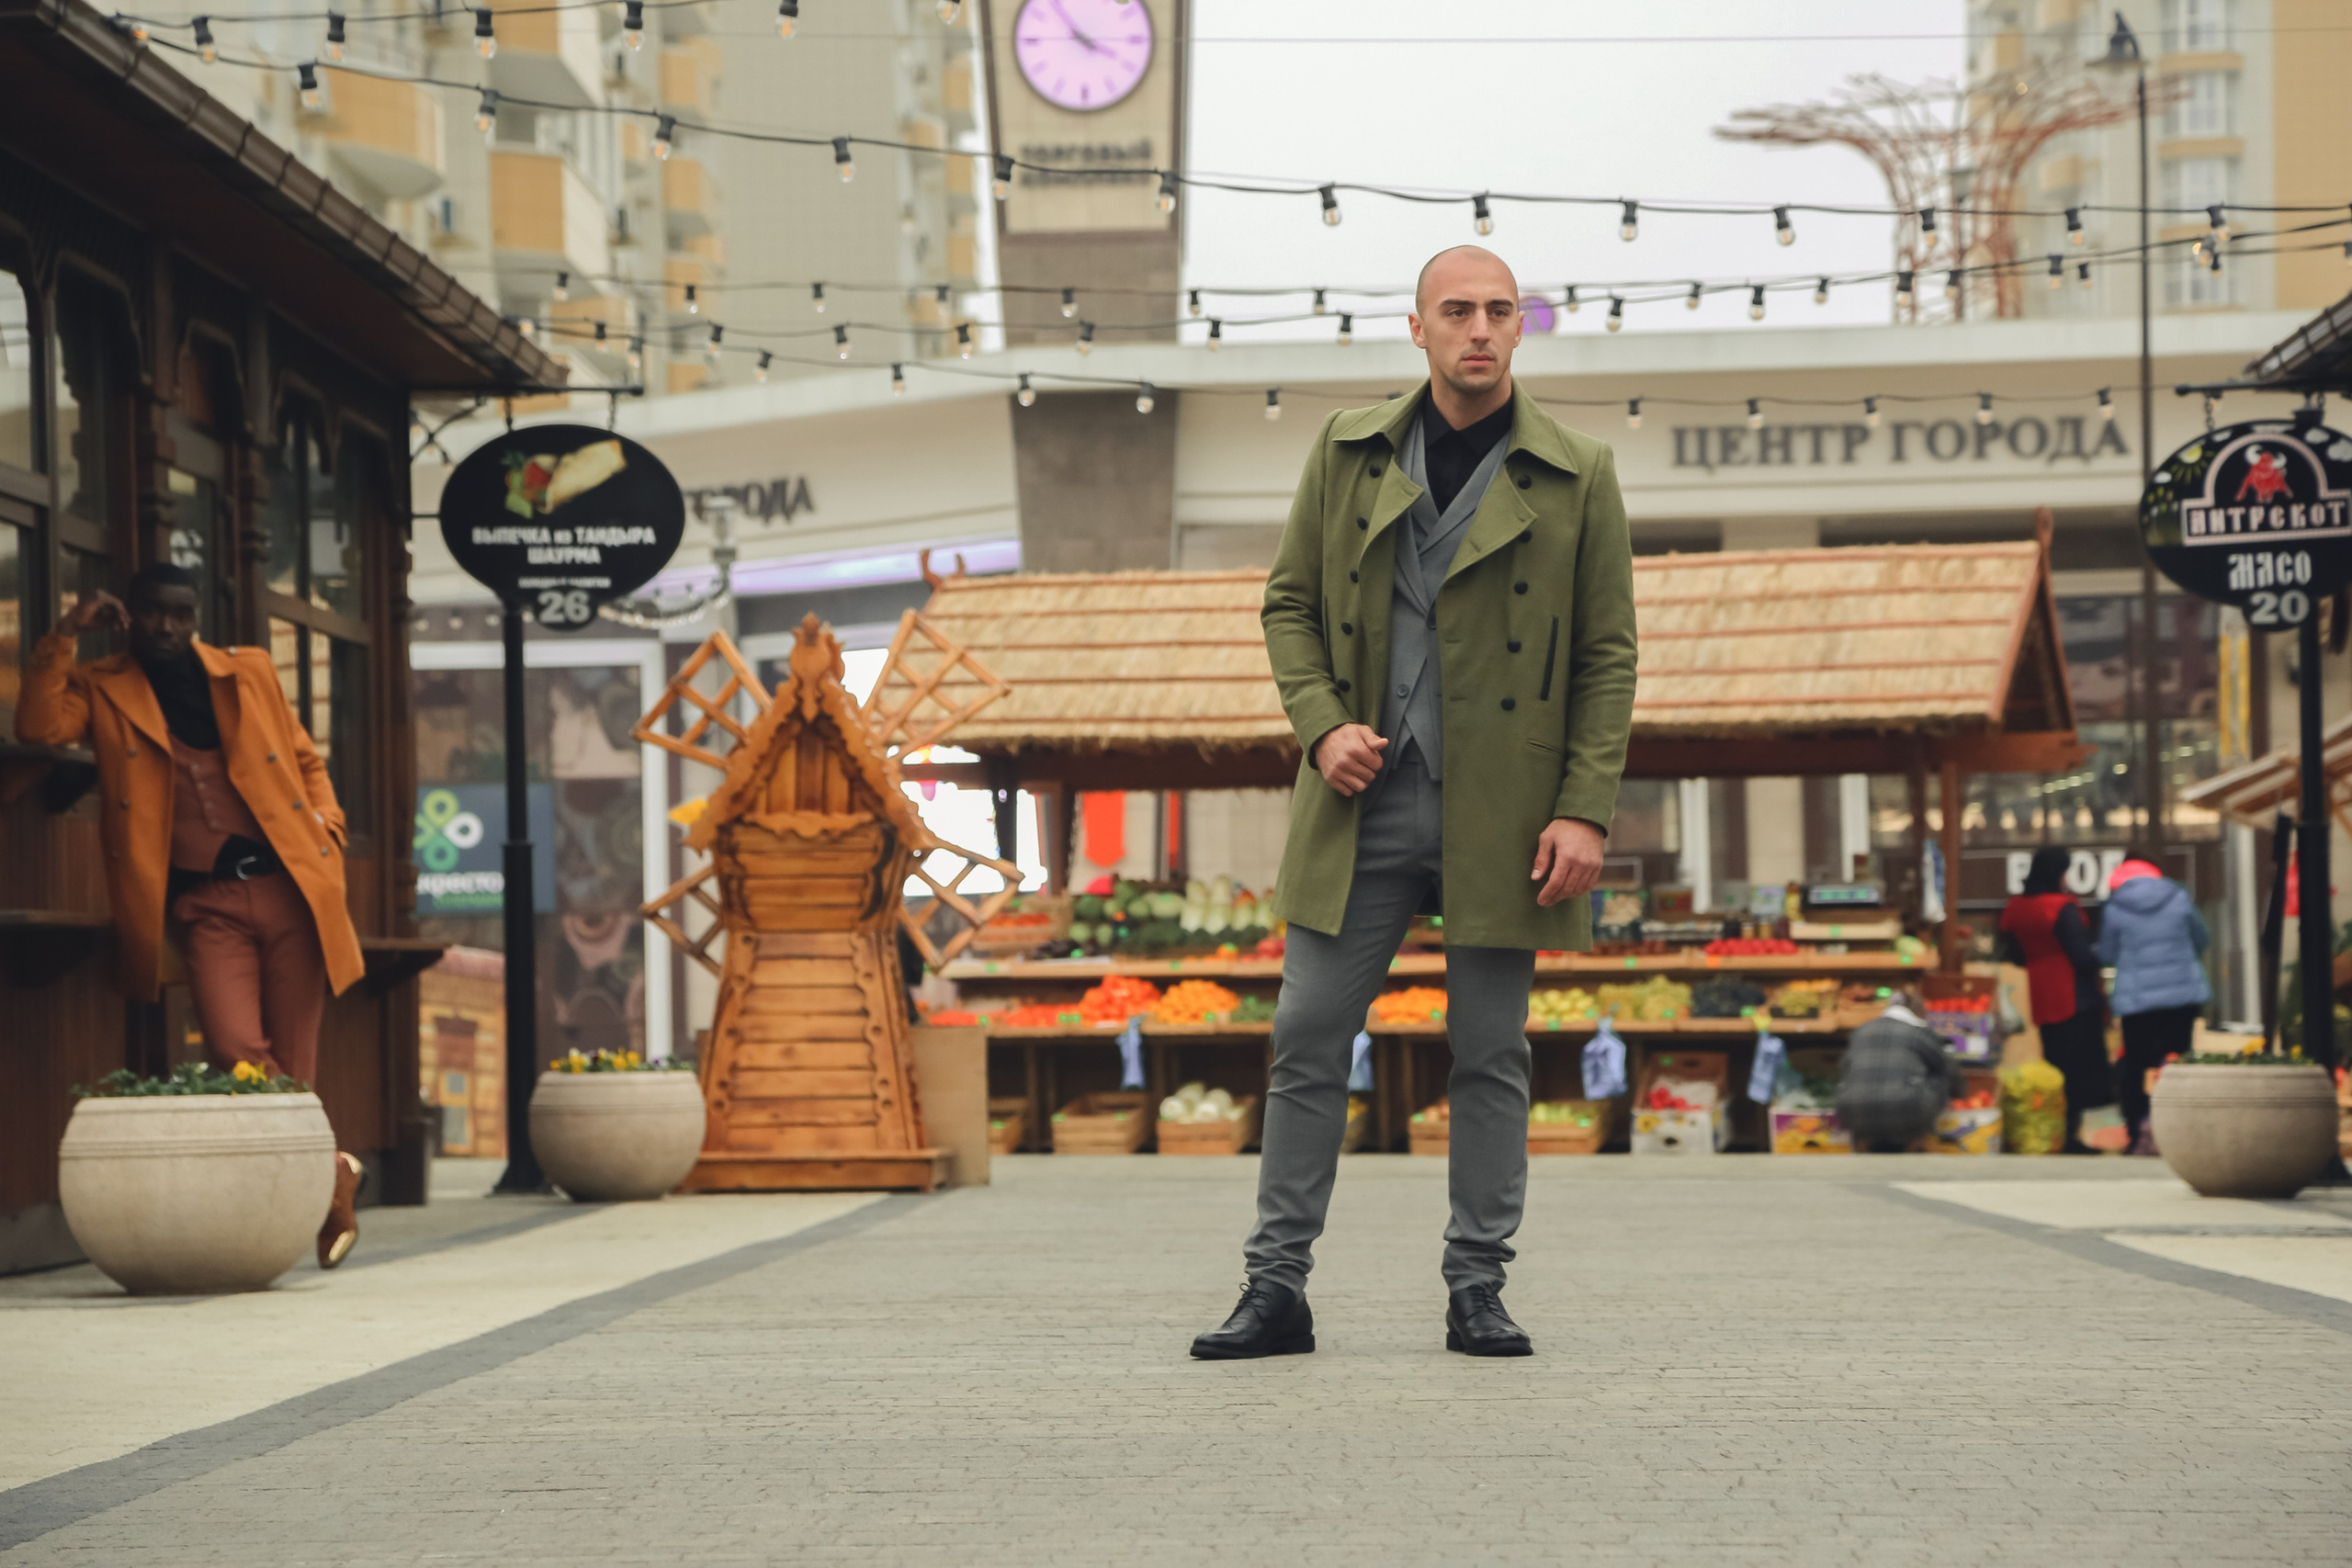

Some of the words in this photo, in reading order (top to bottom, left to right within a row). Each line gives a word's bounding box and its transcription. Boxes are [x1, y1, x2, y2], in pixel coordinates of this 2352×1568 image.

[1671, 423, 1871, 474] ЦЕНТР
[1889, 415, 2130, 468] ГОРОДА
[472, 526, 551, 545] ВЫПЕЧКА
[574, 526, 657, 547] ТАНДЫРА
[527, 546, 602, 564] ШАУРМА
[2228, 550, 2312, 591] МЯСО
[537, 590, 591, 625] 26
[2252, 590, 2310, 625] 20
